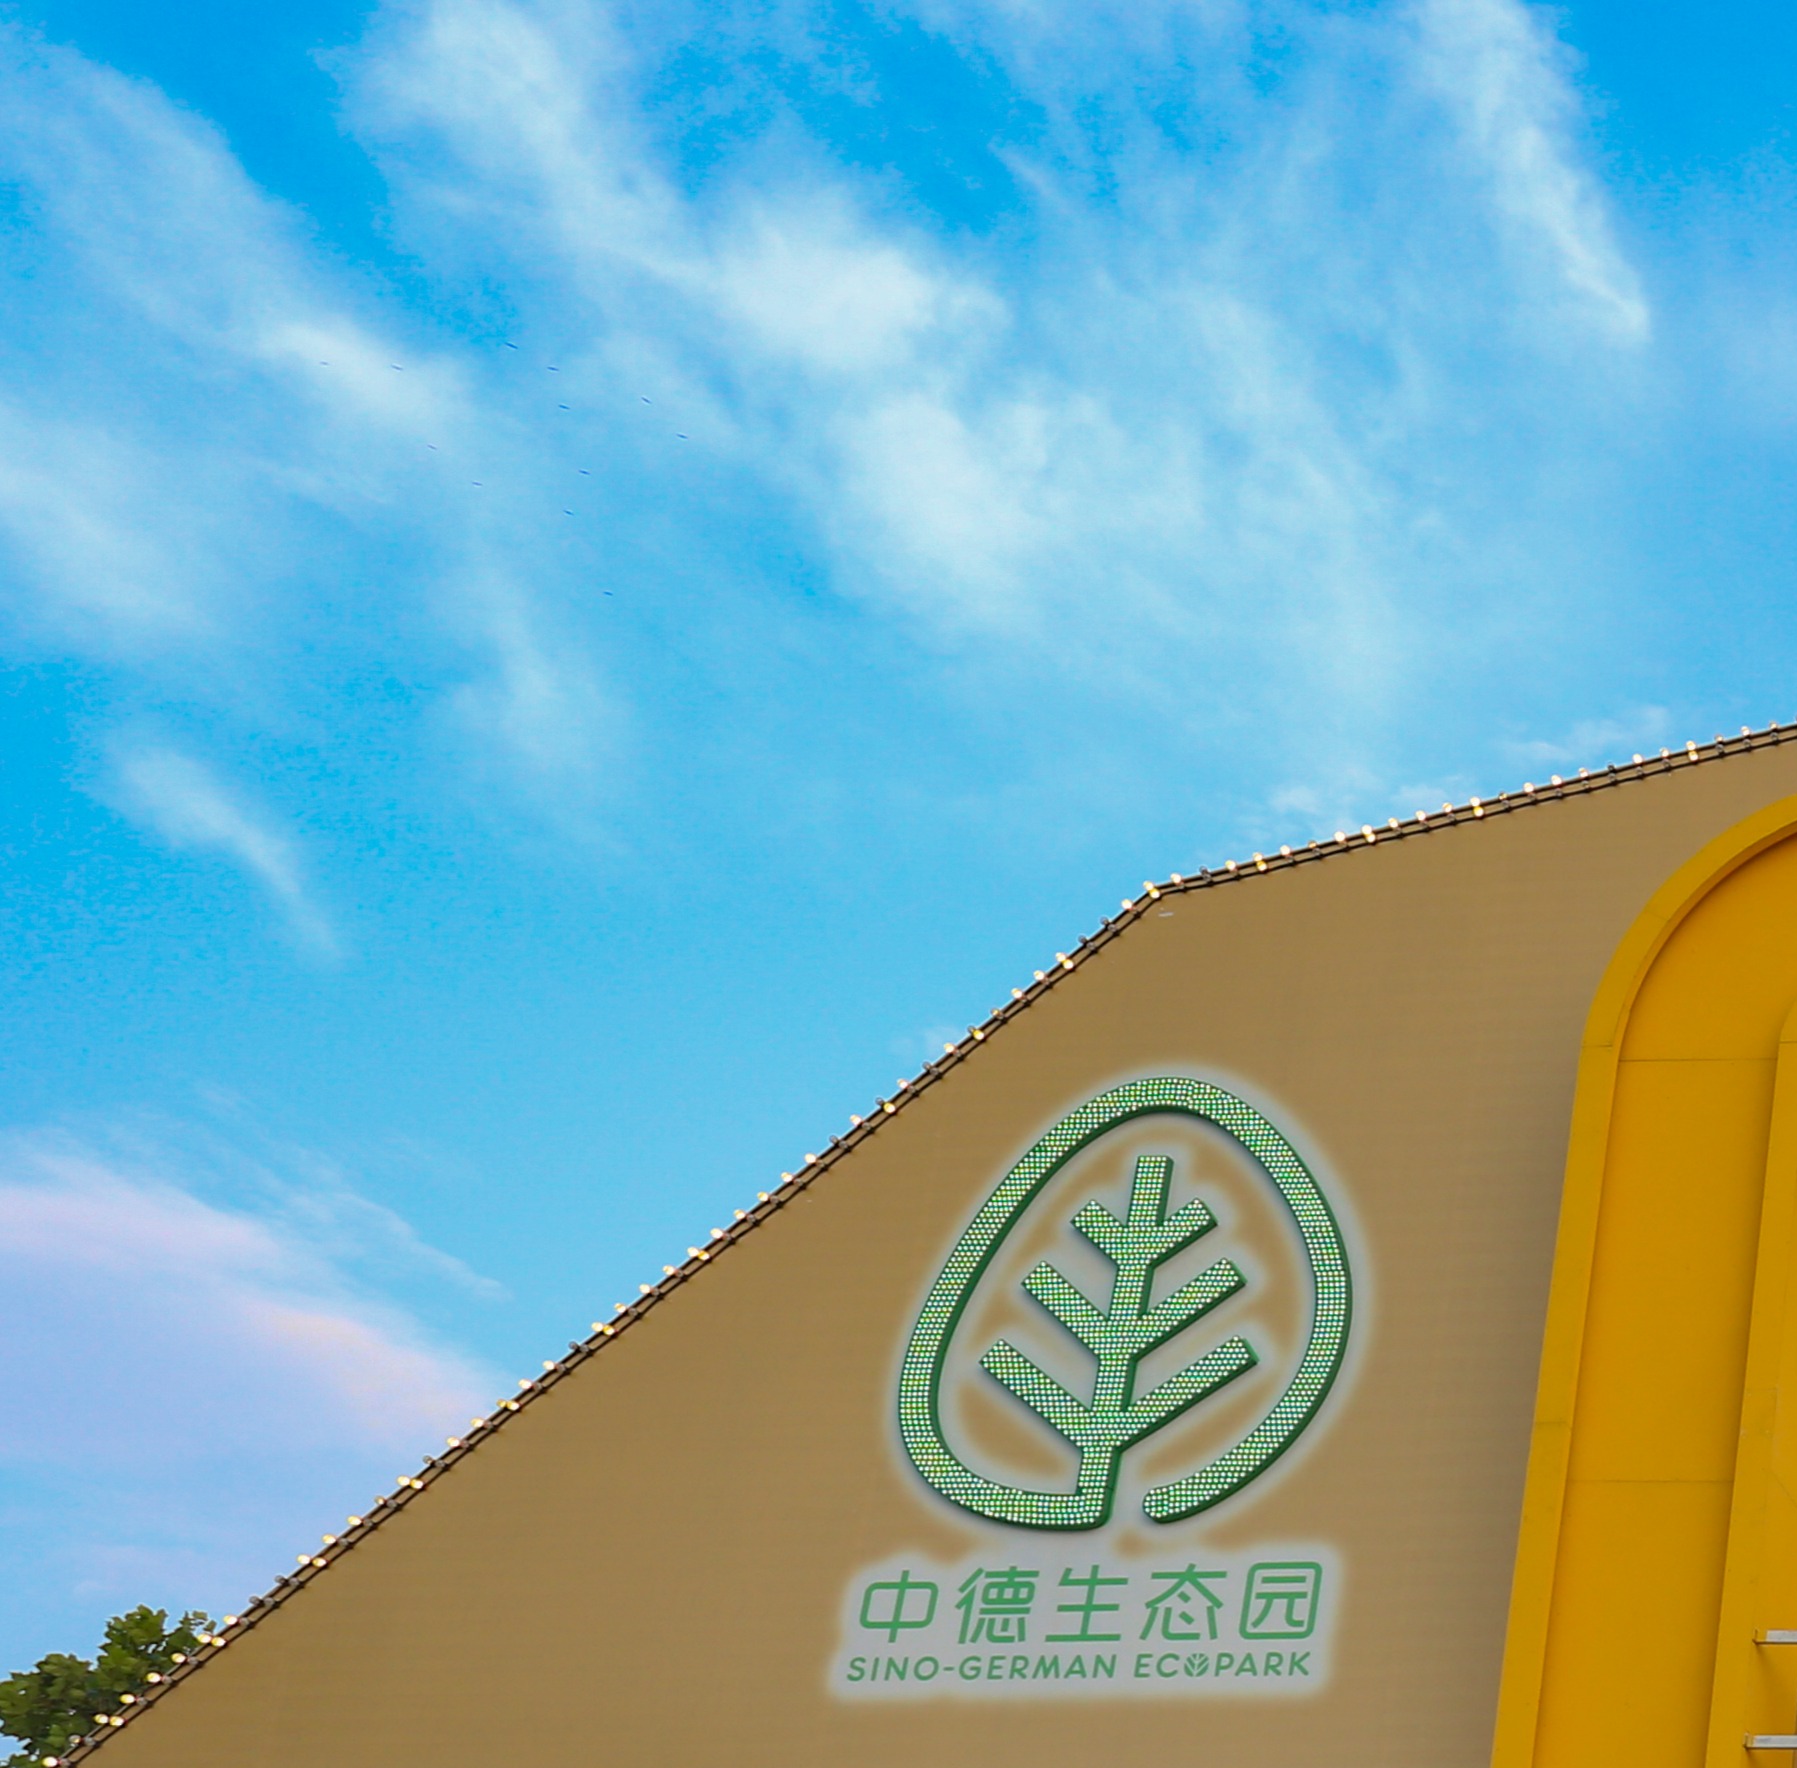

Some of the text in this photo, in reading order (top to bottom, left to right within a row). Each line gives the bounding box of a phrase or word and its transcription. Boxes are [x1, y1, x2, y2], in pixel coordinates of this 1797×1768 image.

[858, 1561, 1322, 1644] 中德生态园
[847, 1653, 1117, 1681] SINO-GERMAN
